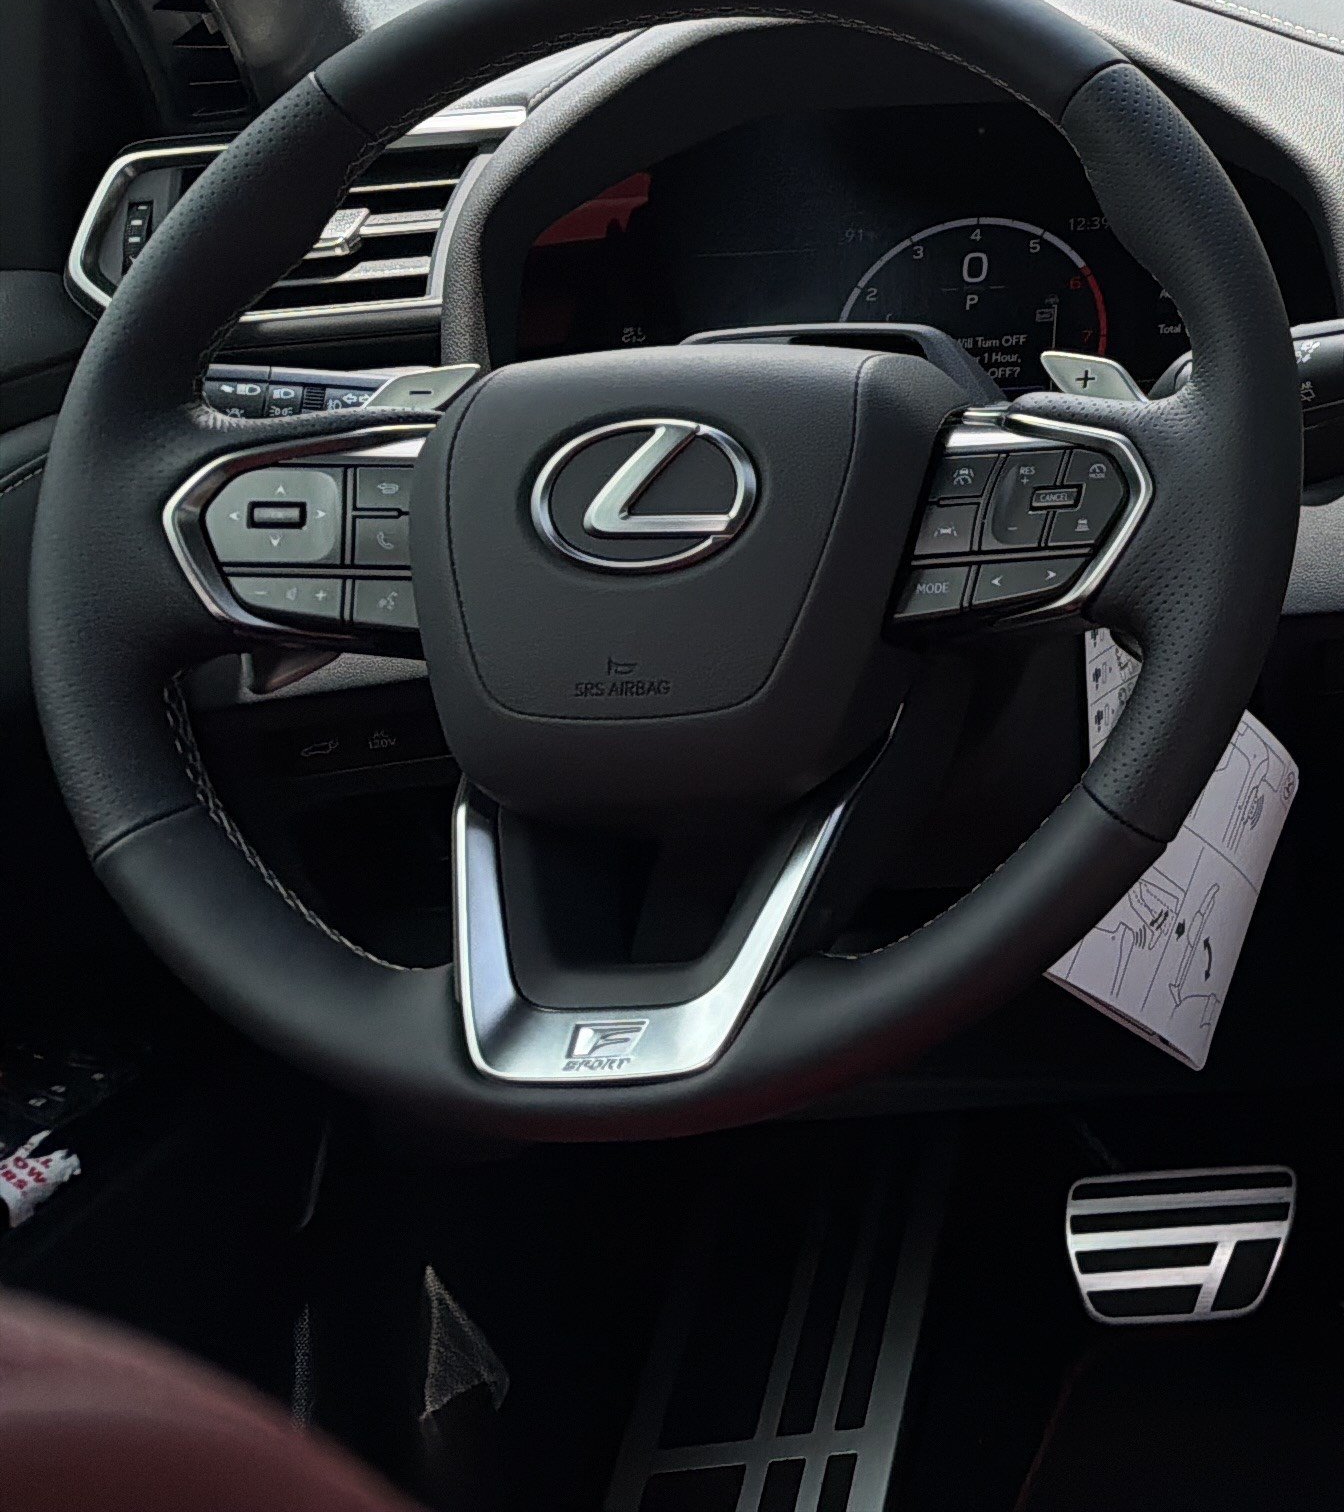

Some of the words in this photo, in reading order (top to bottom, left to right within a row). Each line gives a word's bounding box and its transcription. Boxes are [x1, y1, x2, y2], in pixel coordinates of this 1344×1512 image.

[970, 229, 983, 242] 4
[912, 246, 925, 260] 3
[1029, 239, 1041, 253] 5
[962, 252, 988, 284] 0
[1069, 277, 1081, 290] 6
[865, 288, 878, 302] 2
[965, 294, 979, 310] P
[1158, 324, 1182, 334] Total
[976, 336, 1000, 348] Turn
[1002, 334, 1028, 347] OFF
[988, 367, 1021, 379] OFF?
[1019, 466, 1035, 476] RES
[1039, 492, 1069, 502] CANCEL
[915, 582, 950, 595] MODE
[574, 682, 605, 697] SRS
[608, 680, 671, 697] AIRBAG
[562, 1058, 631, 1072] SPORT
